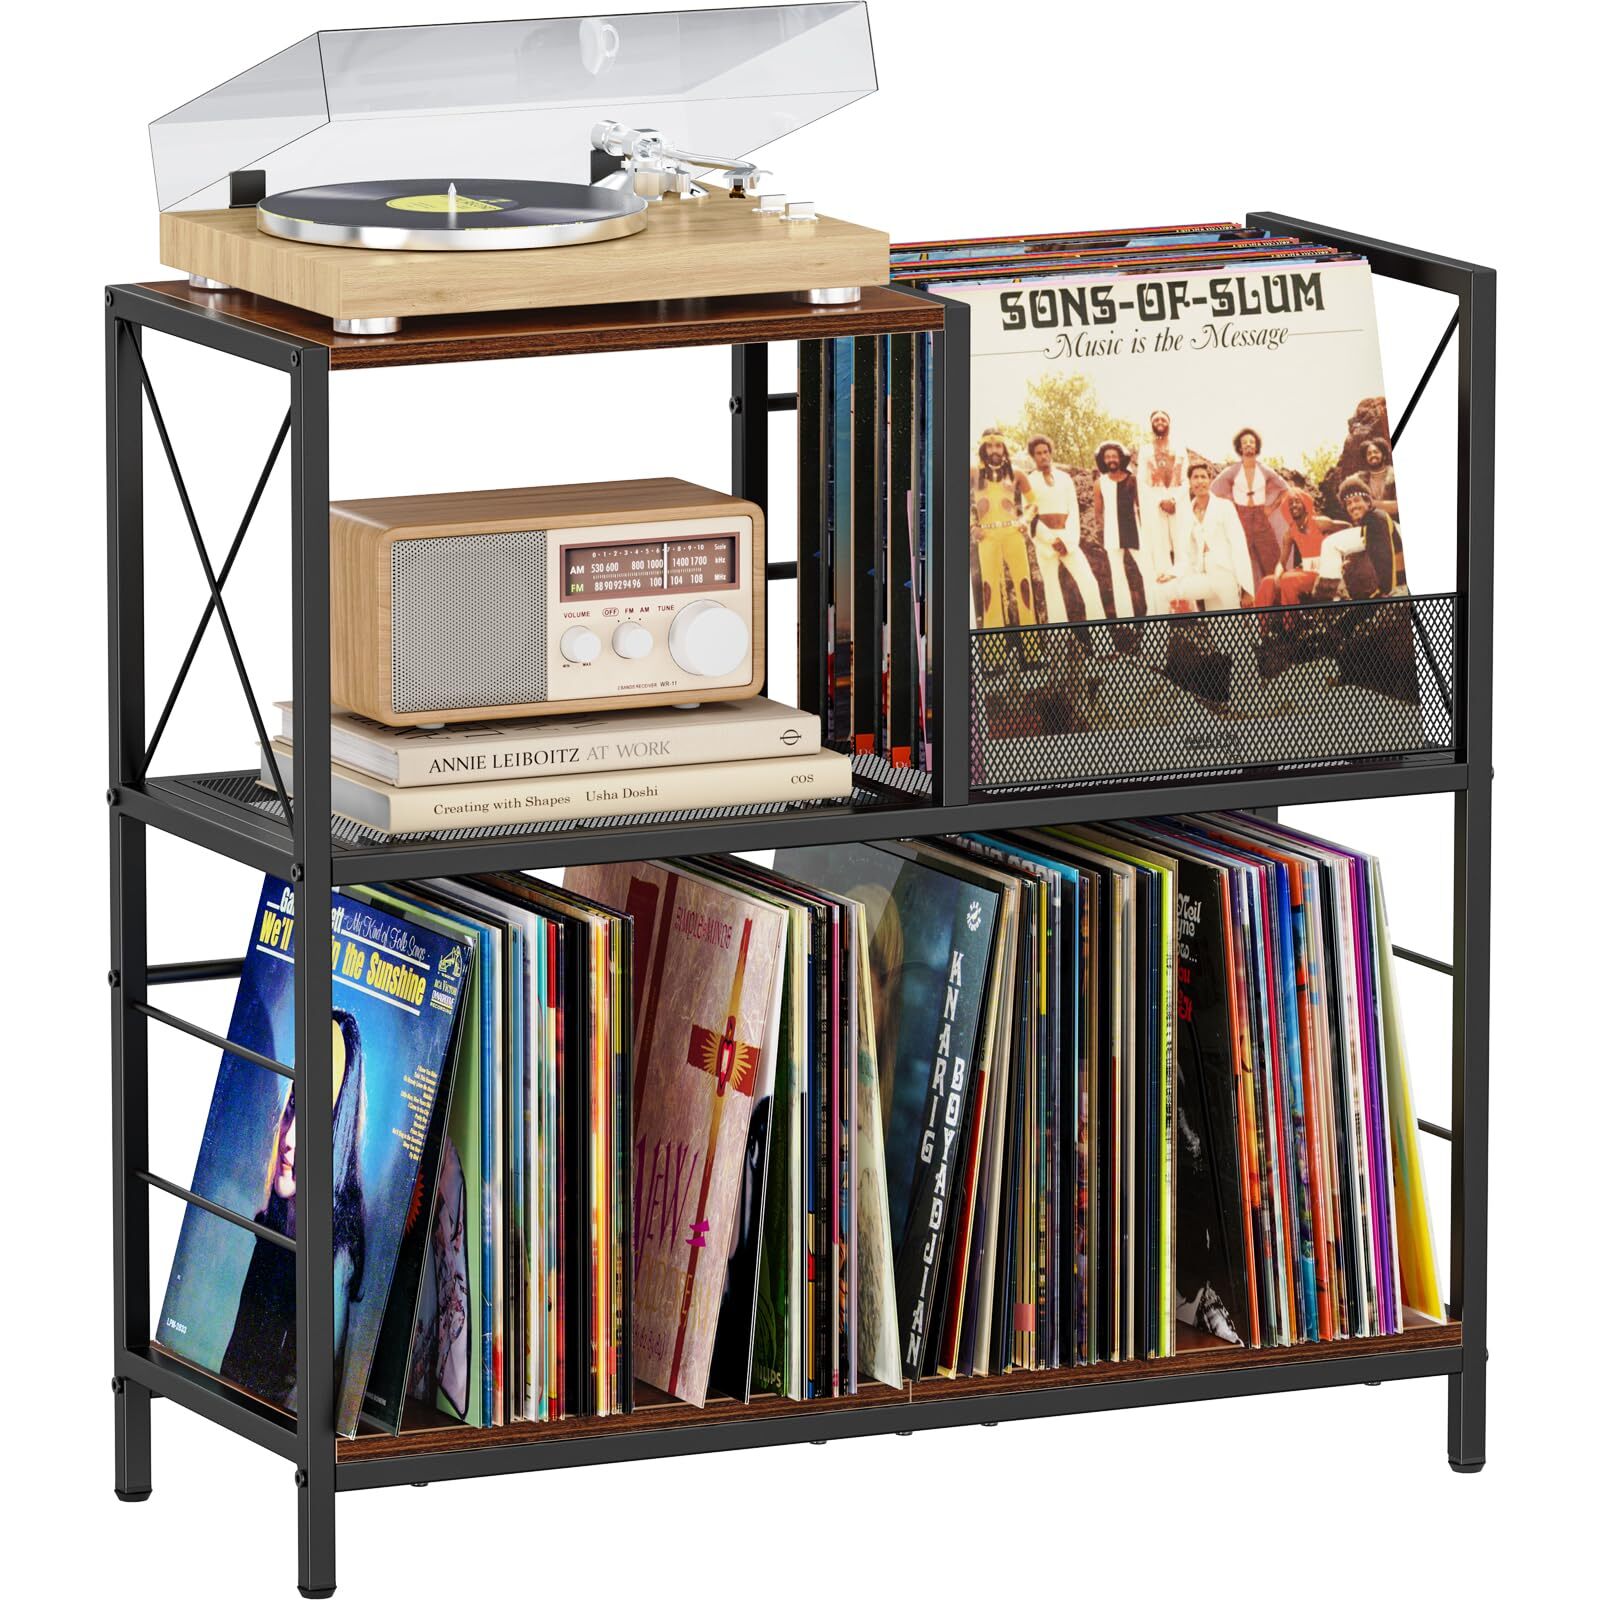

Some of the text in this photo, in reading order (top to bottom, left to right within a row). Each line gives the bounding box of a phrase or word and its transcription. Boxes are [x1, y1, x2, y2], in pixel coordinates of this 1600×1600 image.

[1000, 272, 1325, 331] SONS-OF-SLUM
[1044, 321, 1289, 360] Music is the Message
[570, 565, 585, 575] AM
[591, 564, 604, 574] 530
[605, 562, 619, 572] 600
[631, 560, 644, 570] 800
[647, 559, 664, 569] 1000
[673, 557, 689, 567] 1400
[690, 556, 707, 566] 1700
[570, 584, 584, 593] FM
[594, 582, 604, 592] 88
[604, 581, 613, 591] 90
[614, 580, 622, 590] 92
[622, 579, 632, 589] 94
[632, 579, 641, 588] 96
[650, 577, 662, 587] 100
[670, 575, 683, 585] 104
[691, 574, 704, 584] 108
[563, 611, 591, 619] VOLUME
[429, 741, 670, 774] ANNIE LEIBOITZ AT WORK
[791, 774, 814, 785] COS
[433, 785, 658, 816] Creating with Shapes Usha Doshi
[259, 910, 294, 951] We'll
[363, 915, 383, 940] Kind
[381, 925, 391, 949] of
[390, 928, 408, 951] Folk
[407, 936, 426, 961] Songs
[342, 941, 365, 980] the
[366, 952, 427, 1006] Sunshine
[920, 950, 965, 1163] KNARIG
